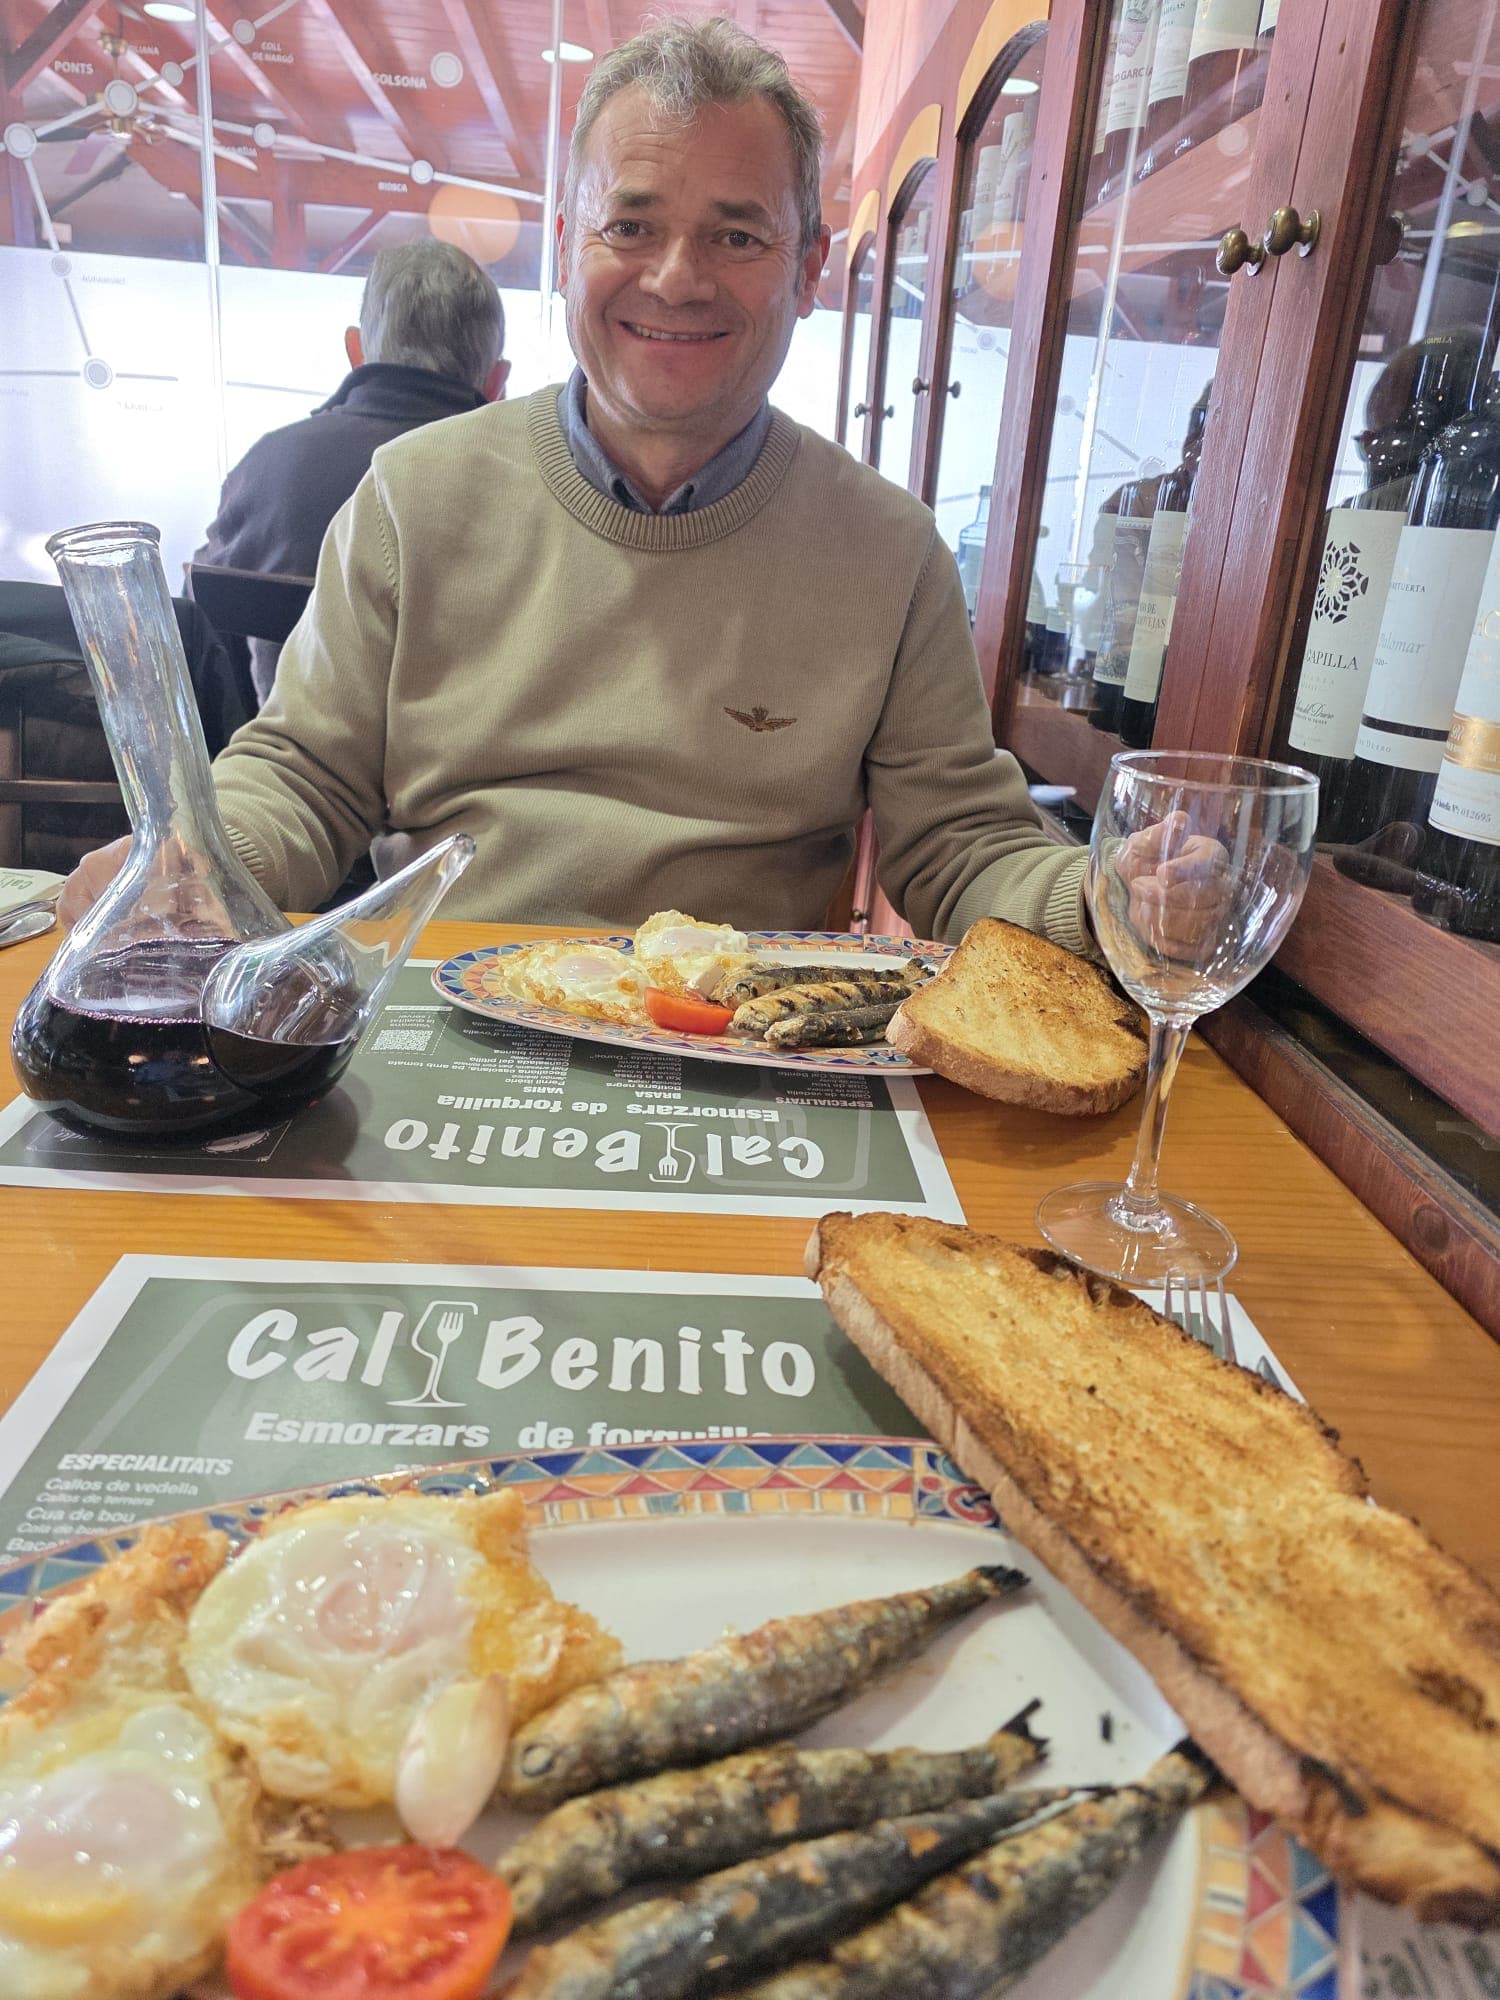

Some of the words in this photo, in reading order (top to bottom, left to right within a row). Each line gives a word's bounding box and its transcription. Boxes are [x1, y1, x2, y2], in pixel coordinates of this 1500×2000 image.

[260, 41, 283, 52] COLL
[54, 61, 94, 76] PONTS
[373, 72, 428, 89] SOLSONA
[523, 1086, 564, 1094] VARIS
[635, 1091, 681, 1099] BRASA
[437, 1093, 562, 1113] forquilla
[571, 1099, 608, 1116] de
[775, 1096, 874, 1108] ESPECIALITATS
[626, 1100, 780, 1122] Esmorzars
[384, 1118, 642, 1174] Benito
[706, 1132, 825, 1179] Cal
[226, 1307, 405, 1389] Cal
[475, 1315, 817, 1398] Benito
[243, 1412, 490, 1449] Esmorzars
[518, 1421, 574, 1449] de
[57, 1453, 234, 1476] ESPECIALITATS
[45, 1478, 102, 1491] Callos
[106, 1478, 131, 1492] de
[135, 1481, 199, 1496] vedella
[26, 1507, 65, 1521] Cua
[68, 1508, 95, 1522] de
[97, 1509, 136, 1523] bou
